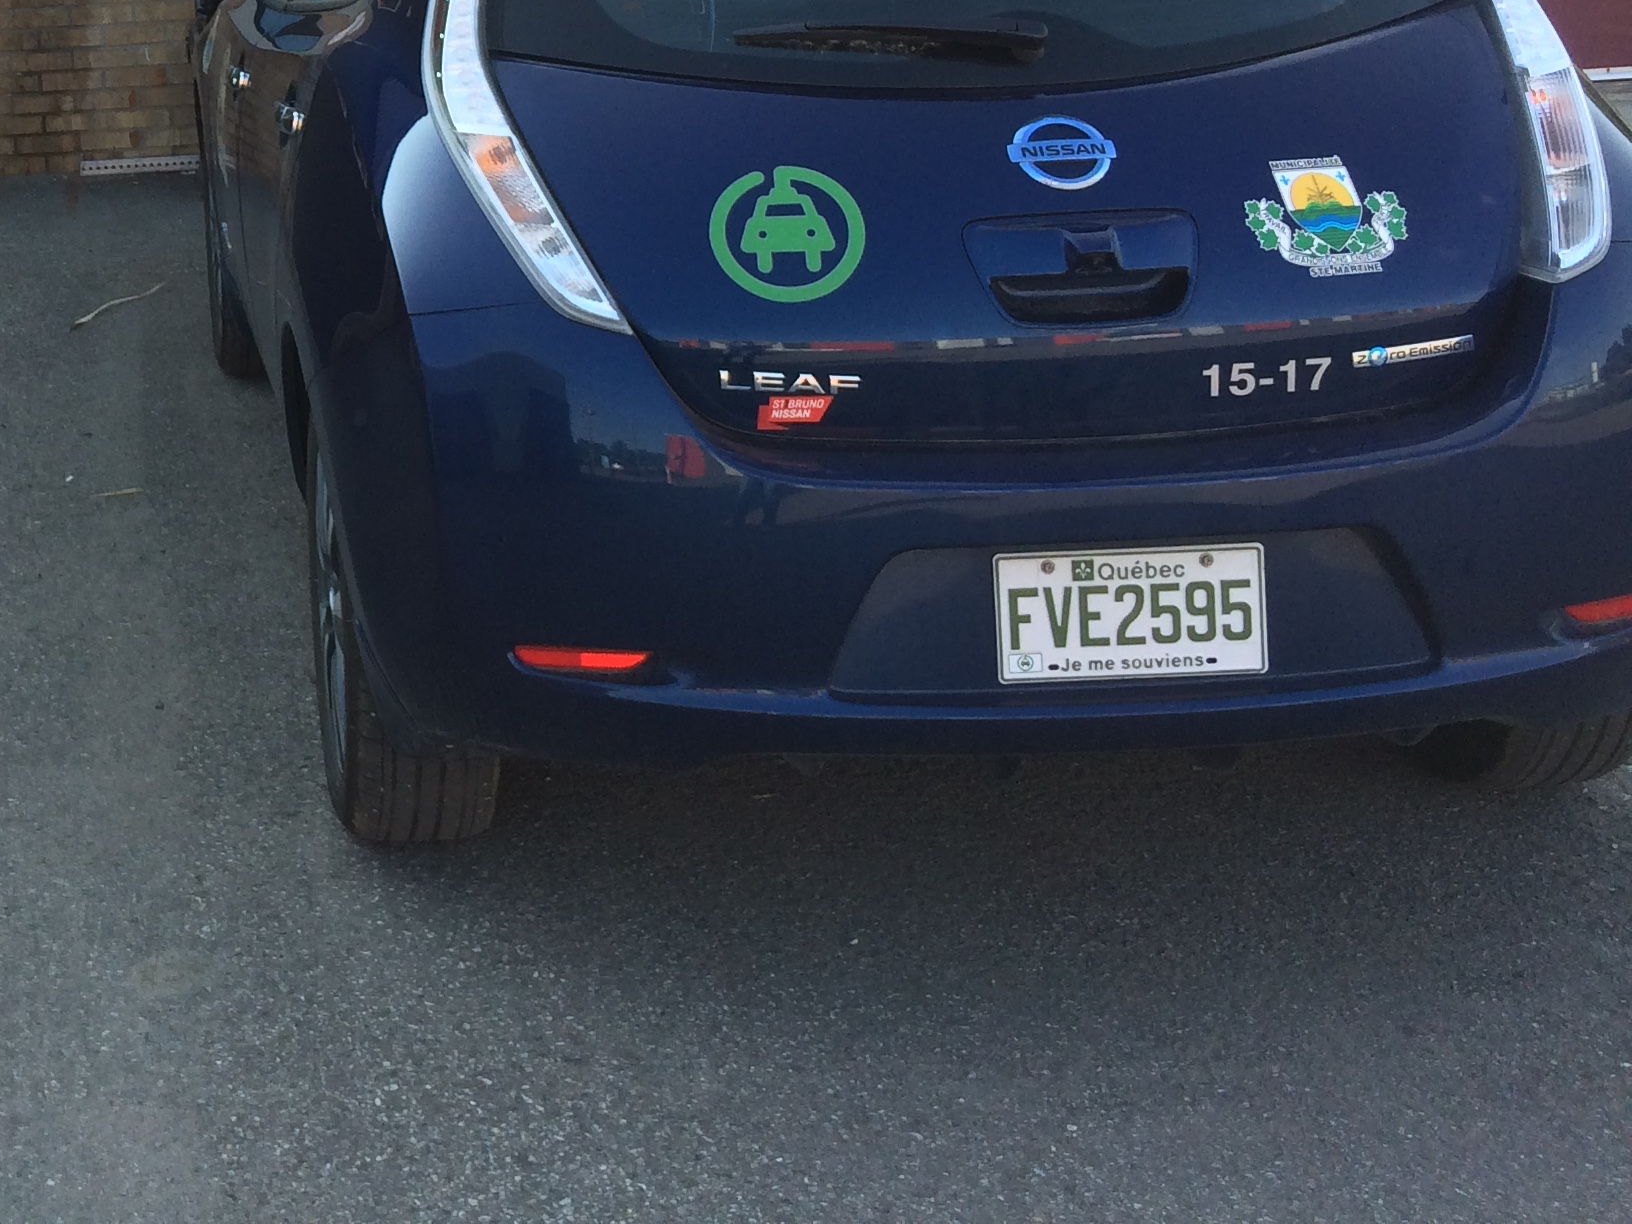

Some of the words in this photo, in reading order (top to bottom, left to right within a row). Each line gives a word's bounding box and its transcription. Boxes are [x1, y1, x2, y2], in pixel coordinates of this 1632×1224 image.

[1020, 142, 1107, 158] NISSAN
[1310, 267, 1333, 277] STE
[1334, 263, 1382, 274] MARTINE
[1409, 339, 1472, 357] Emission
[718, 369, 863, 395] LEAF
[1202, 356, 1332, 397] 15-17
[772, 399, 785, 409] ST
[787, 398, 825, 409] BRUNO
[771, 408, 811, 419] NISSAN
[1097, 560, 1186, 581] Québec
[1007, 579, 1253, 651] FVE2595
[1060, 658, 1083, 672] Je
[1088, 658, 1116, 671] me
[1120, 653, 1205, 670] souviens
